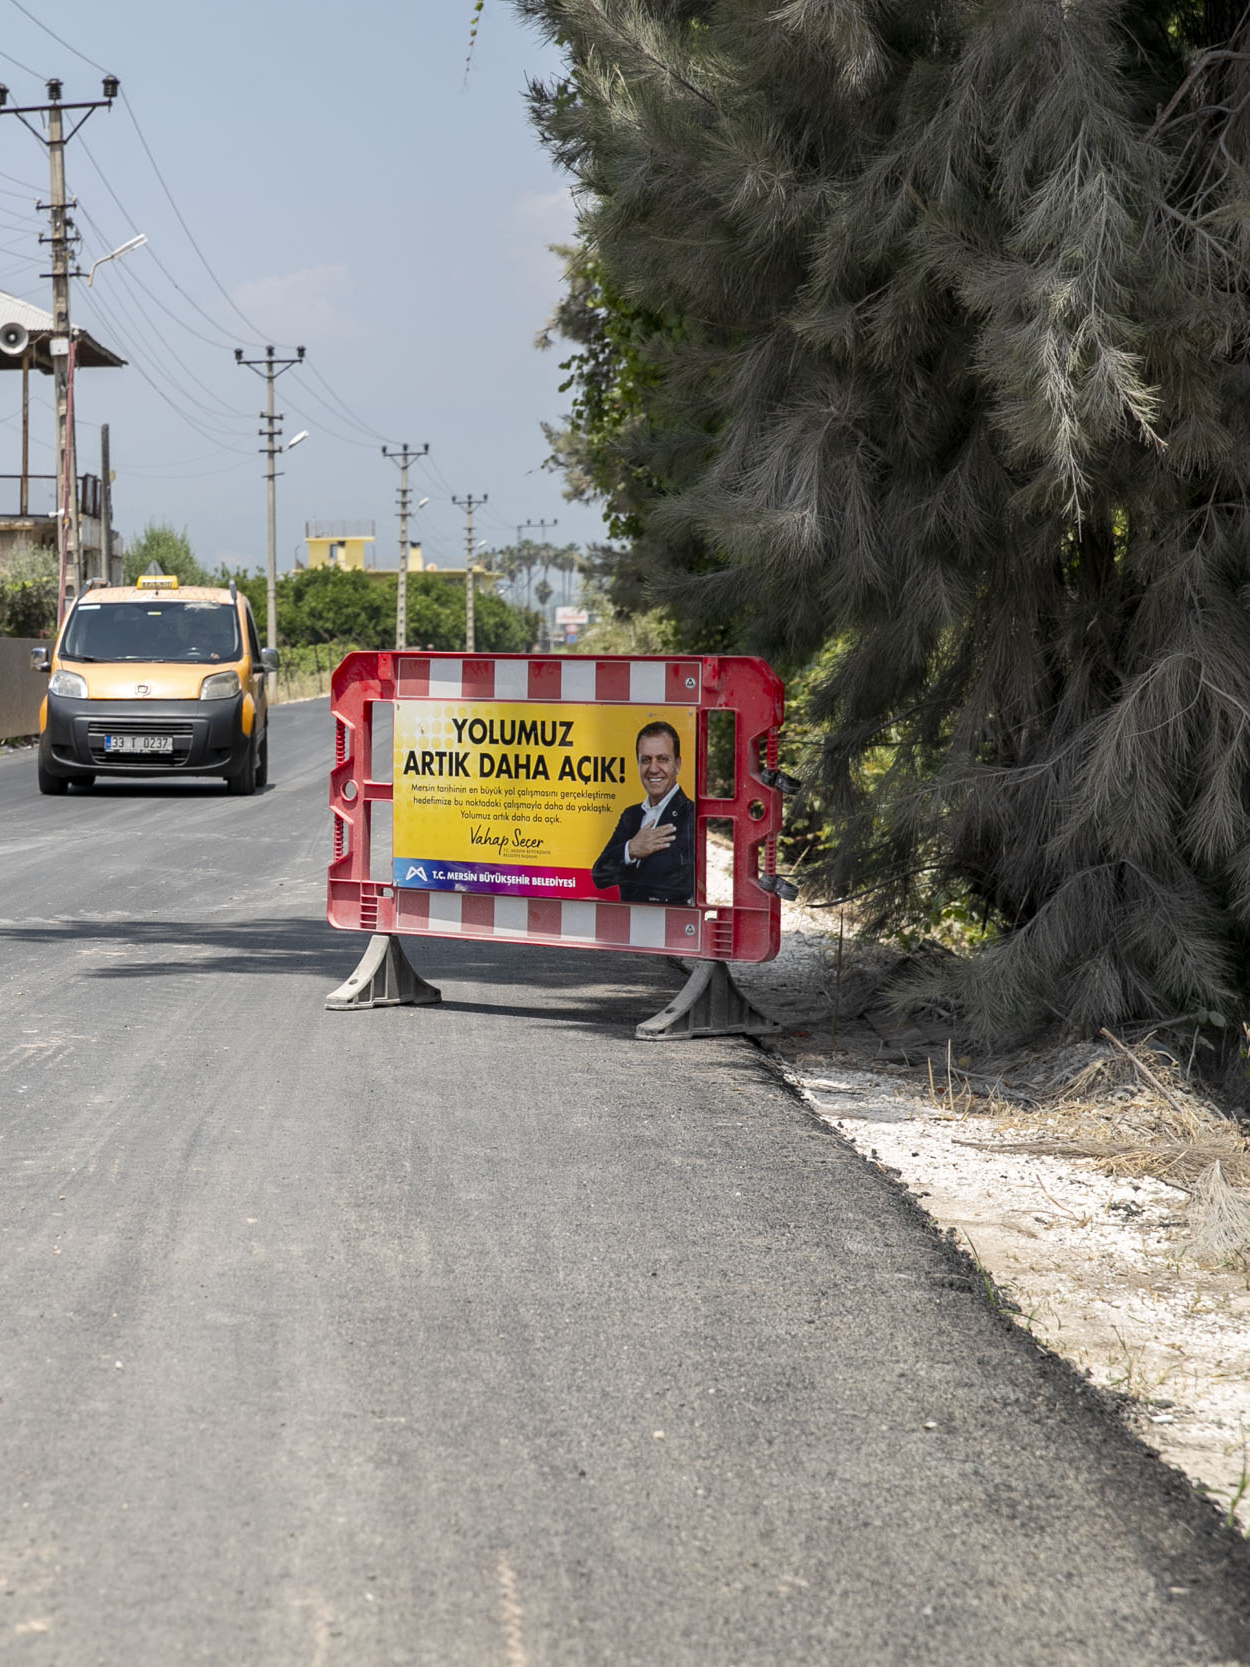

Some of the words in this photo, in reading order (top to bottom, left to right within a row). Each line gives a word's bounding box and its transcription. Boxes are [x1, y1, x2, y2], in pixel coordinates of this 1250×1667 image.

[452, 718, 574, 747] YOLUMUZ
[112, 737, 124, 748] 33
[131, 737, 136, 748] T
[143, 737, 168, 749] 0237
[403, 750, 471, 778] ARTIK
[479, 752, 550, 780] DAHA
[558, 755, 626, 785] AÇIK!
[411, 784, 435, 792] Mersin
[437, 784, 467, 793] tarihinin
[481, 786, 502, 796] büyük
[504, 788, 515, 797] yol
[518, 787, 558, 798] çalışmasını
[560, 789, 616, 801] gerçekleştirme
[413, 795, 452, 806] hedefimize
[454, 797, 464, 806] bu
[466, 798, 502, 808] noktadaki
[504, 800, 542, 811] çalışmayla
[544, 802, 564, 811] daha
[566, 803, 576, 811] da
[578, 803, 614, 814] yaklaştık.
[461, 810, 491, 820] Yolumuz
[493, 812, 510, 821] artık
[512, 813, 531, 822] daha
[533, 814, 543, 823] da
[545, 814, 563, 825] açık.
[470, 824, 509, 856] Vahap
[432, 870, 445, 880] T.C.
[447, 870, 477, 882] MERSİN
[479, 872, 530, 886] BÜYÜKŞEHİR
[532, 876, 576, 888] BELEDİYESİ
